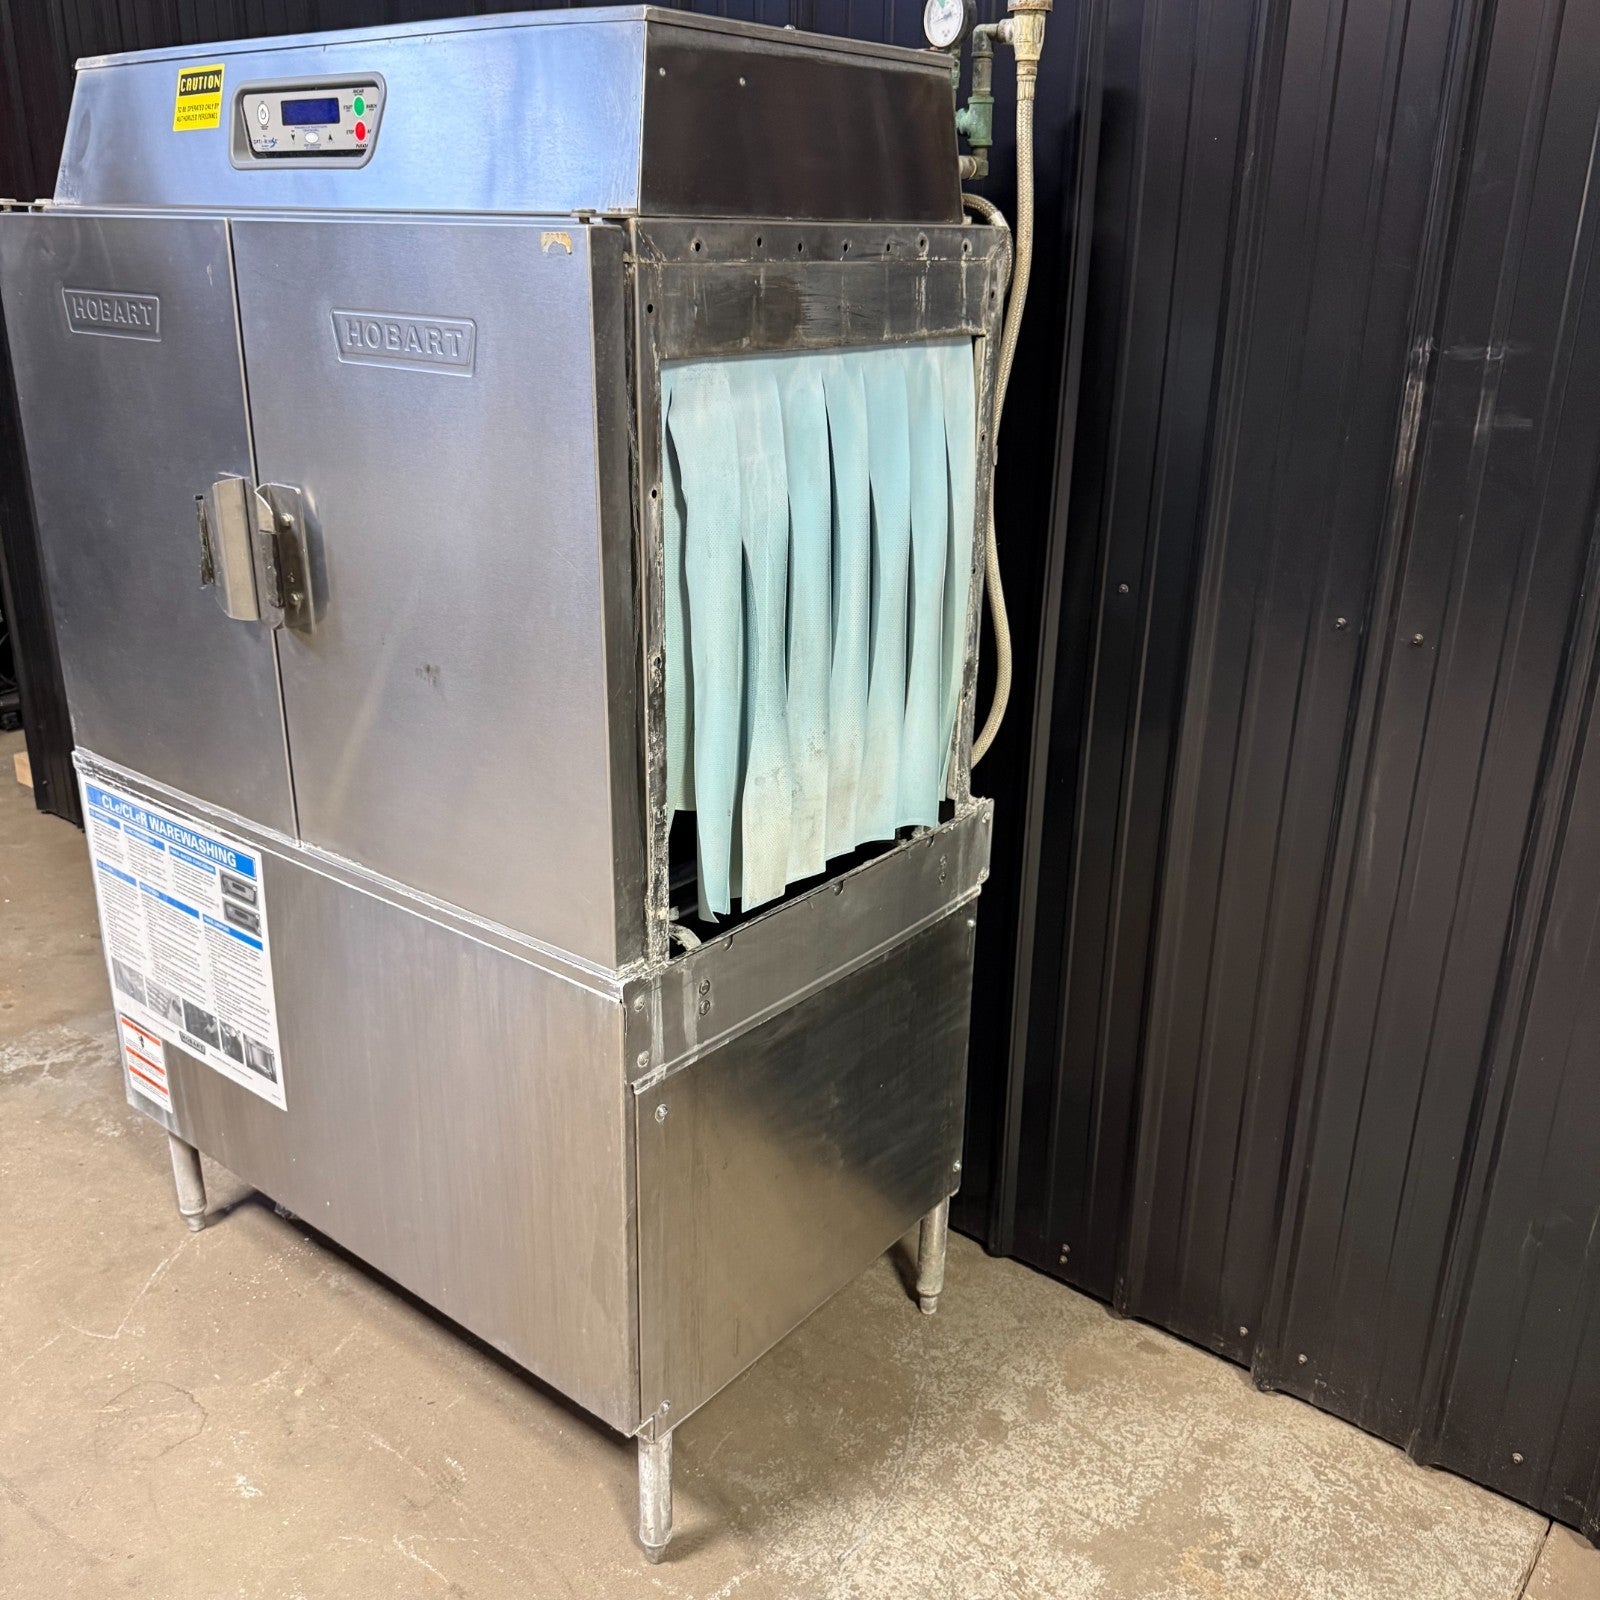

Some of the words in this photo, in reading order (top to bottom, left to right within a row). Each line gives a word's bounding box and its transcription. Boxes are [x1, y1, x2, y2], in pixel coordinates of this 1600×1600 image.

[180, 74, 221, 93] CAUTION
[72, 296, 152, 326] HOBART
[345, 319, 463, 357] HOBART
[148, 813, 237, 868] WAREWASHING
